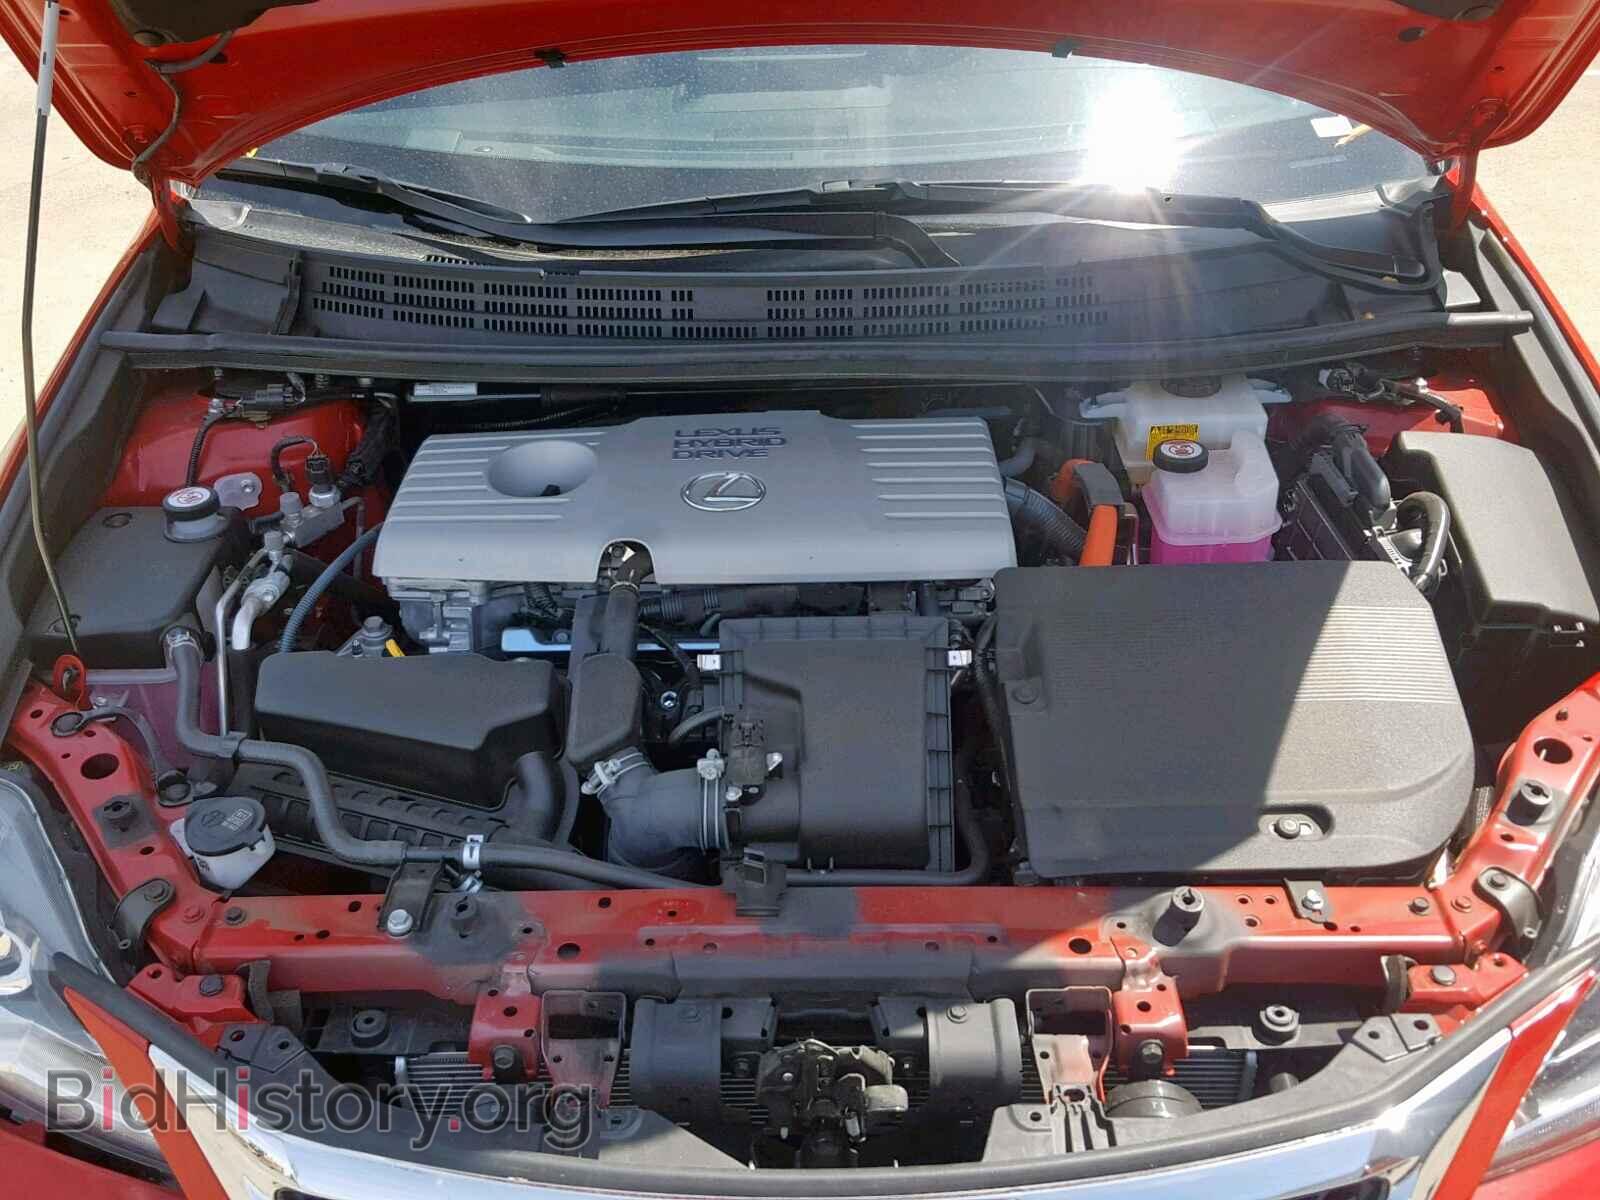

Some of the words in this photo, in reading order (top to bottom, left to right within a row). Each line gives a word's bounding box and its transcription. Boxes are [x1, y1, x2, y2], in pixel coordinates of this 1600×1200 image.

[674, 426, 783, 438] LEXUS
[673, 437, 787, 450] HYBRID
[672, 448, 769, 461] DRIVE
